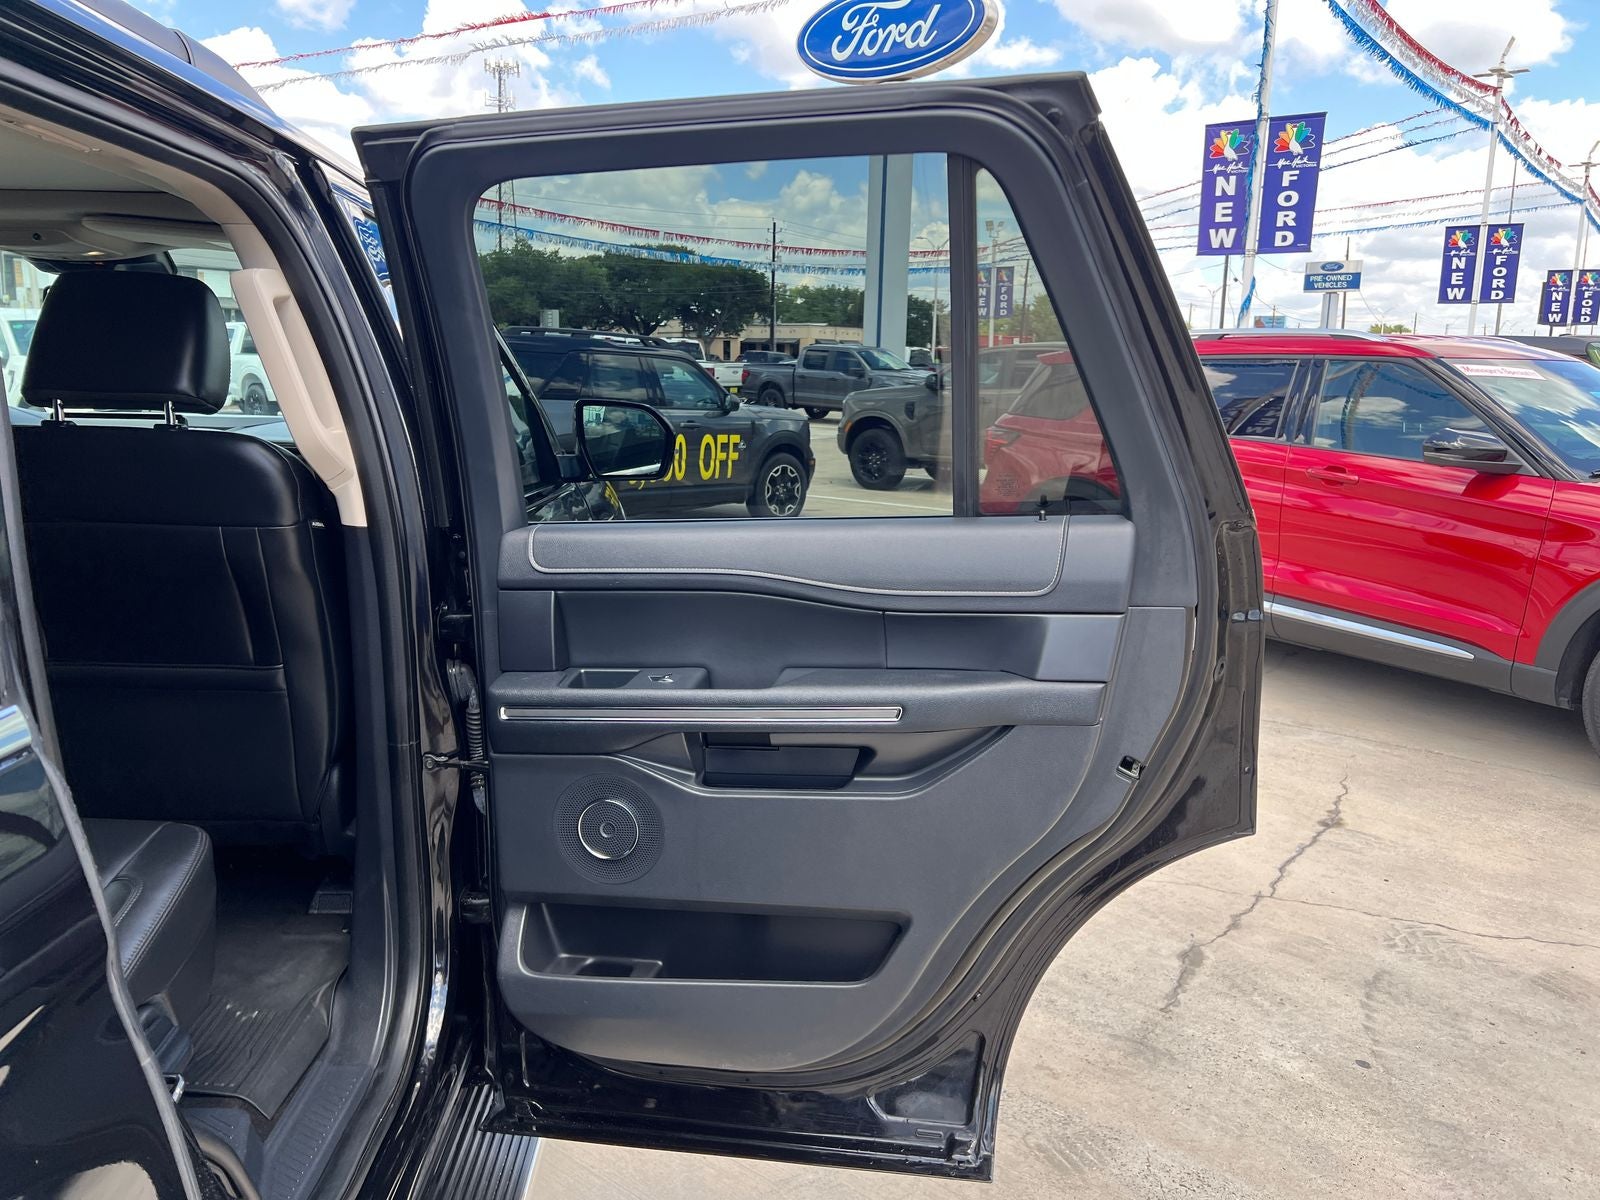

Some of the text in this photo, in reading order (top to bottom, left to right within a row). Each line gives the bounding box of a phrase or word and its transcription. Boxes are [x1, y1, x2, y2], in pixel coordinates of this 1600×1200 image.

[831, 0, 941, 61] Ford
[1209, 175, 1237, 249] NEW
[1273, 170, 1300, 247] FORD
[1309, 274, 1353, 282] PRE-OWNED
[1313, 281, 1348, 289] VEHICLES
[1446, 256, 1466, 300] NEW
[1490, 255, 1508, 300] FORD
[977, 287, 988, 316] NEW
[999, 286, 1009, 316] FORD
[1548, 291, 1563, 323] NEW
[1580, 291, 1594, 323] FORD
[699, 434, 741, 480] OFF
